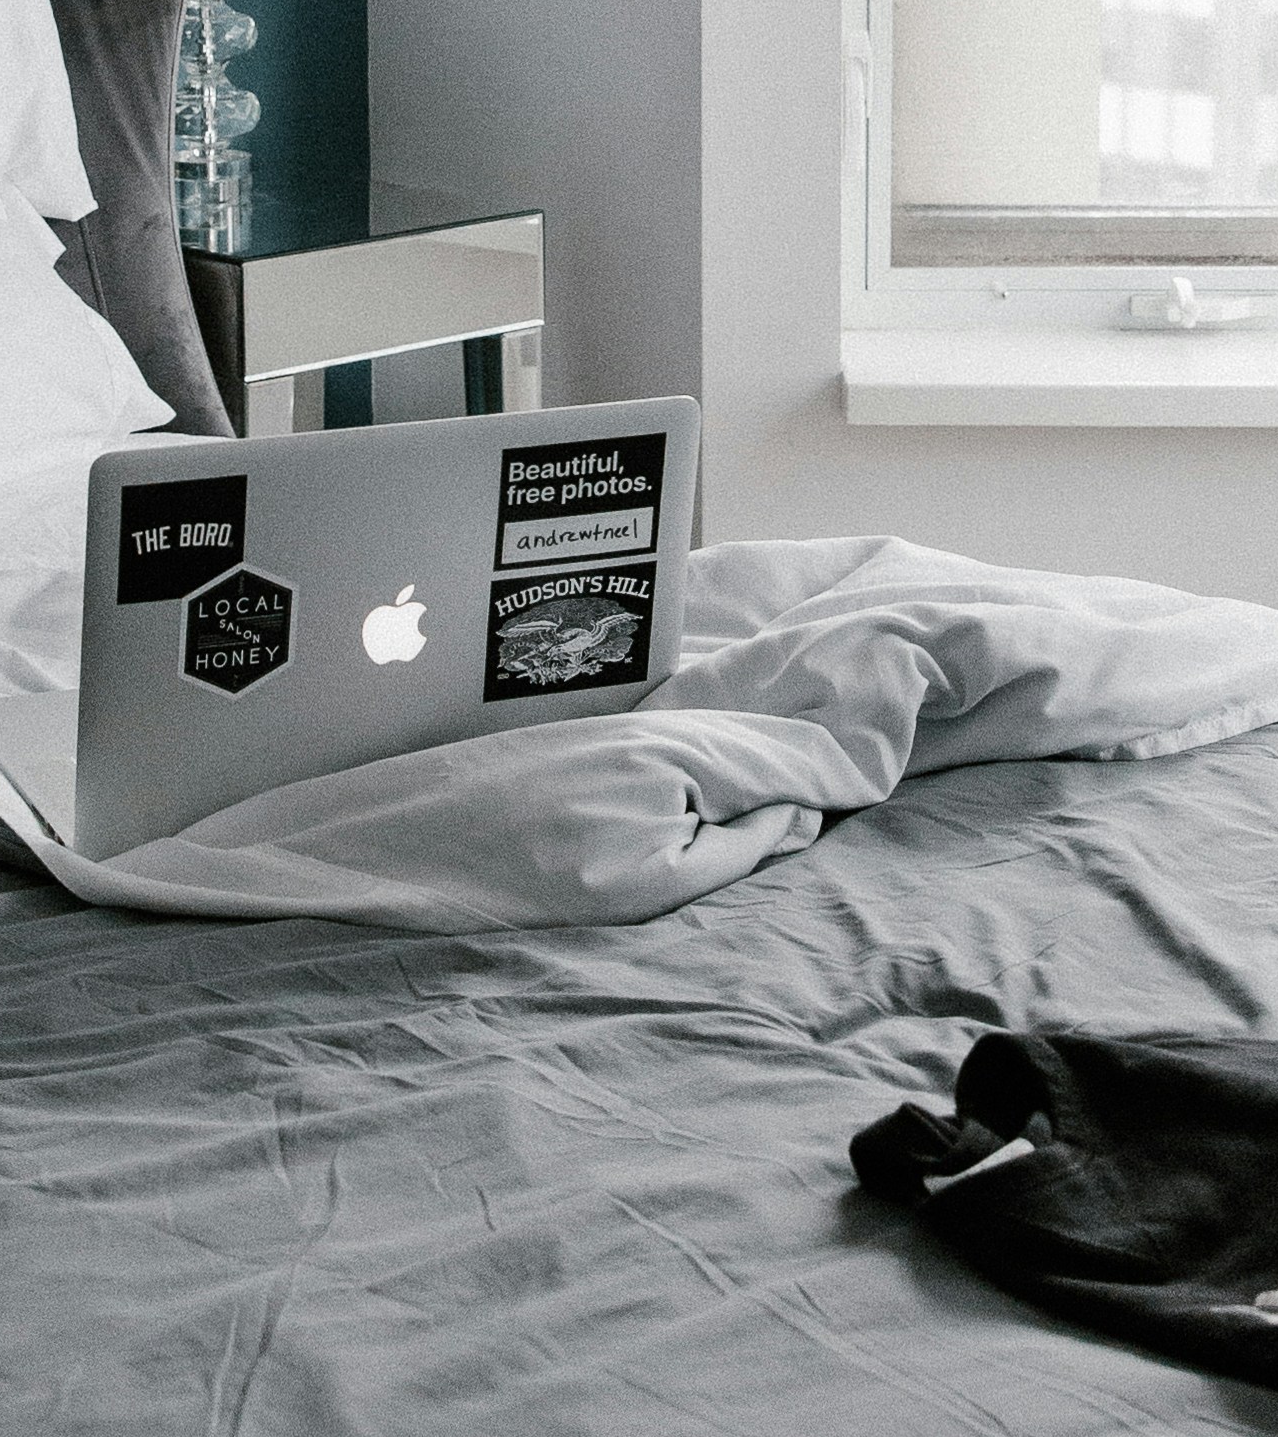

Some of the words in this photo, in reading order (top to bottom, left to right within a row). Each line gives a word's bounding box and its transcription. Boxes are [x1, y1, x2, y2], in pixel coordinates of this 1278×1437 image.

[508, 451, 624, 483] Beautiful,
[507, 485, 555, 505] free
[561, 475, 652, 504] photos.
[131, 526, 171, 555] THE
[198, 594, 283, 618] LOCAL
[494, 575, 603, 617] HUDSON'S
[605, 575, 650, 599] HILL
[219, 619, 260, 643] SALON
[195, 645, 280, 670] HONEY
